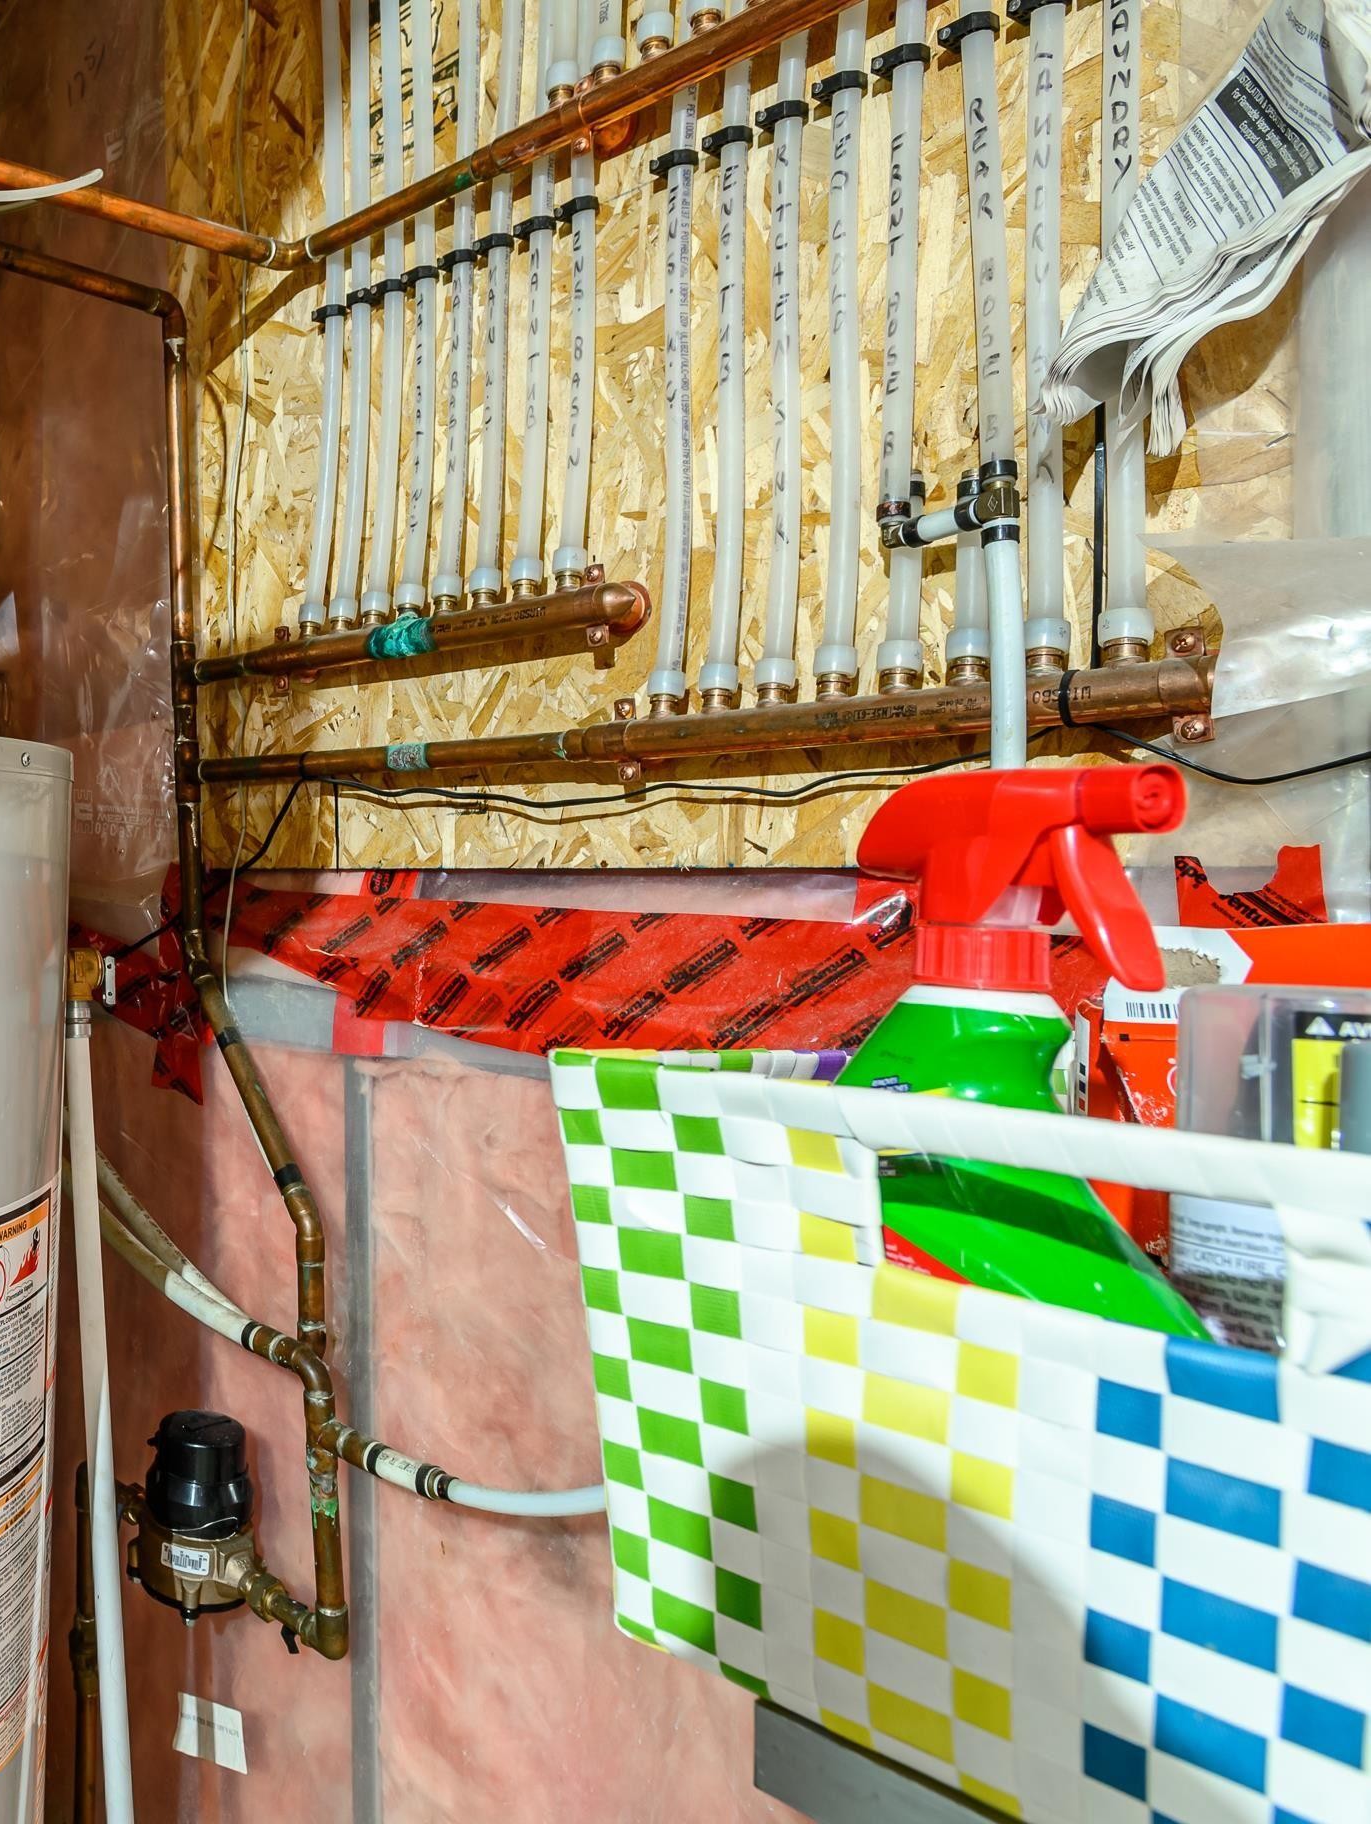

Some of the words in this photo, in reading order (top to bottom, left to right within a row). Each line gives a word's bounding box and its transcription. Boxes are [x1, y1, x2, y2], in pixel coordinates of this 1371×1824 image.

[890, 132, 905, 256] FRONT
[969, 97, 993, 220] REAR
[982, 257, 1000, 380] HOSE
[529, 248, 540, 335] MAIN
[773, 143, 792, 363] KITCHEN
[451, 279, 462, 353] MAIN
[487, 266, 497, 344] MAIN
[886, 291, 900, 395] HOSE
[568, 336, 584, 470] BASIN
[1032, 685, 1092, 703] WISBO
[1176, 860, 1208, 889] ape
